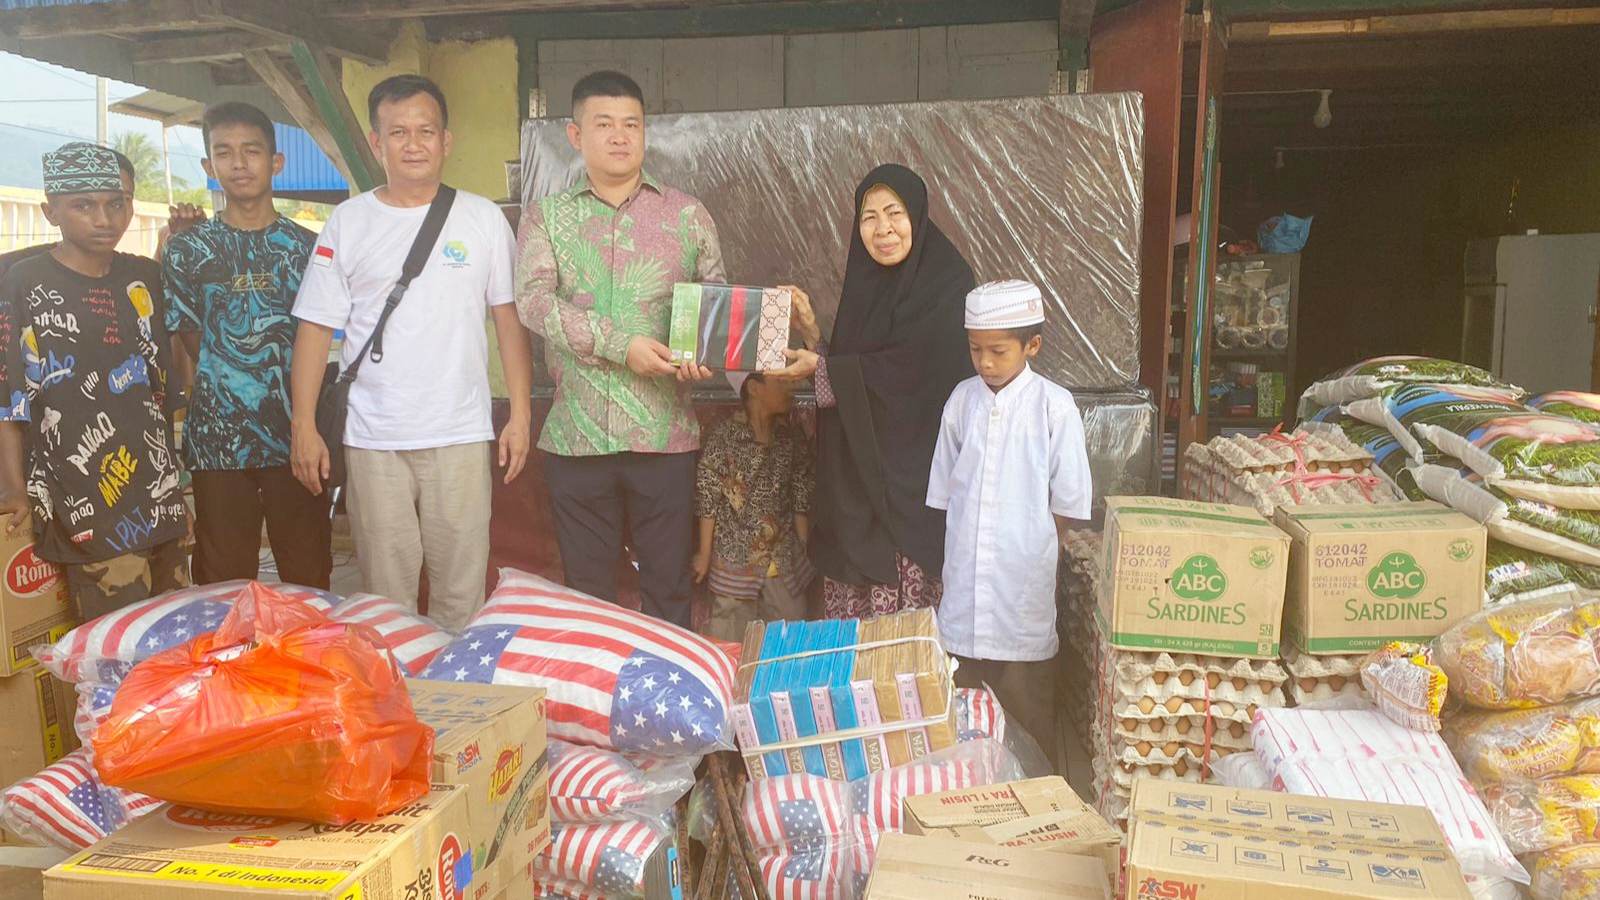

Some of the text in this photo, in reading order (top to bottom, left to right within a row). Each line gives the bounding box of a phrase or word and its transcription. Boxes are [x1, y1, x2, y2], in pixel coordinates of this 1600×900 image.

[1315, 556, 1368, 568] TOMAT
[16, 562, 60, 587] Rom
[1176, 574, 1222, 593] ABC
[1372, 571, 1421, 590] ABC
[1146, 597, 1246, 625] SARDINES
[1344, 597, 1448, 622] SARDINES
[170, 866, 199, 876] No.
[218, 869, 240, 879] di
[239, 870, 328, 886] Indonesia
